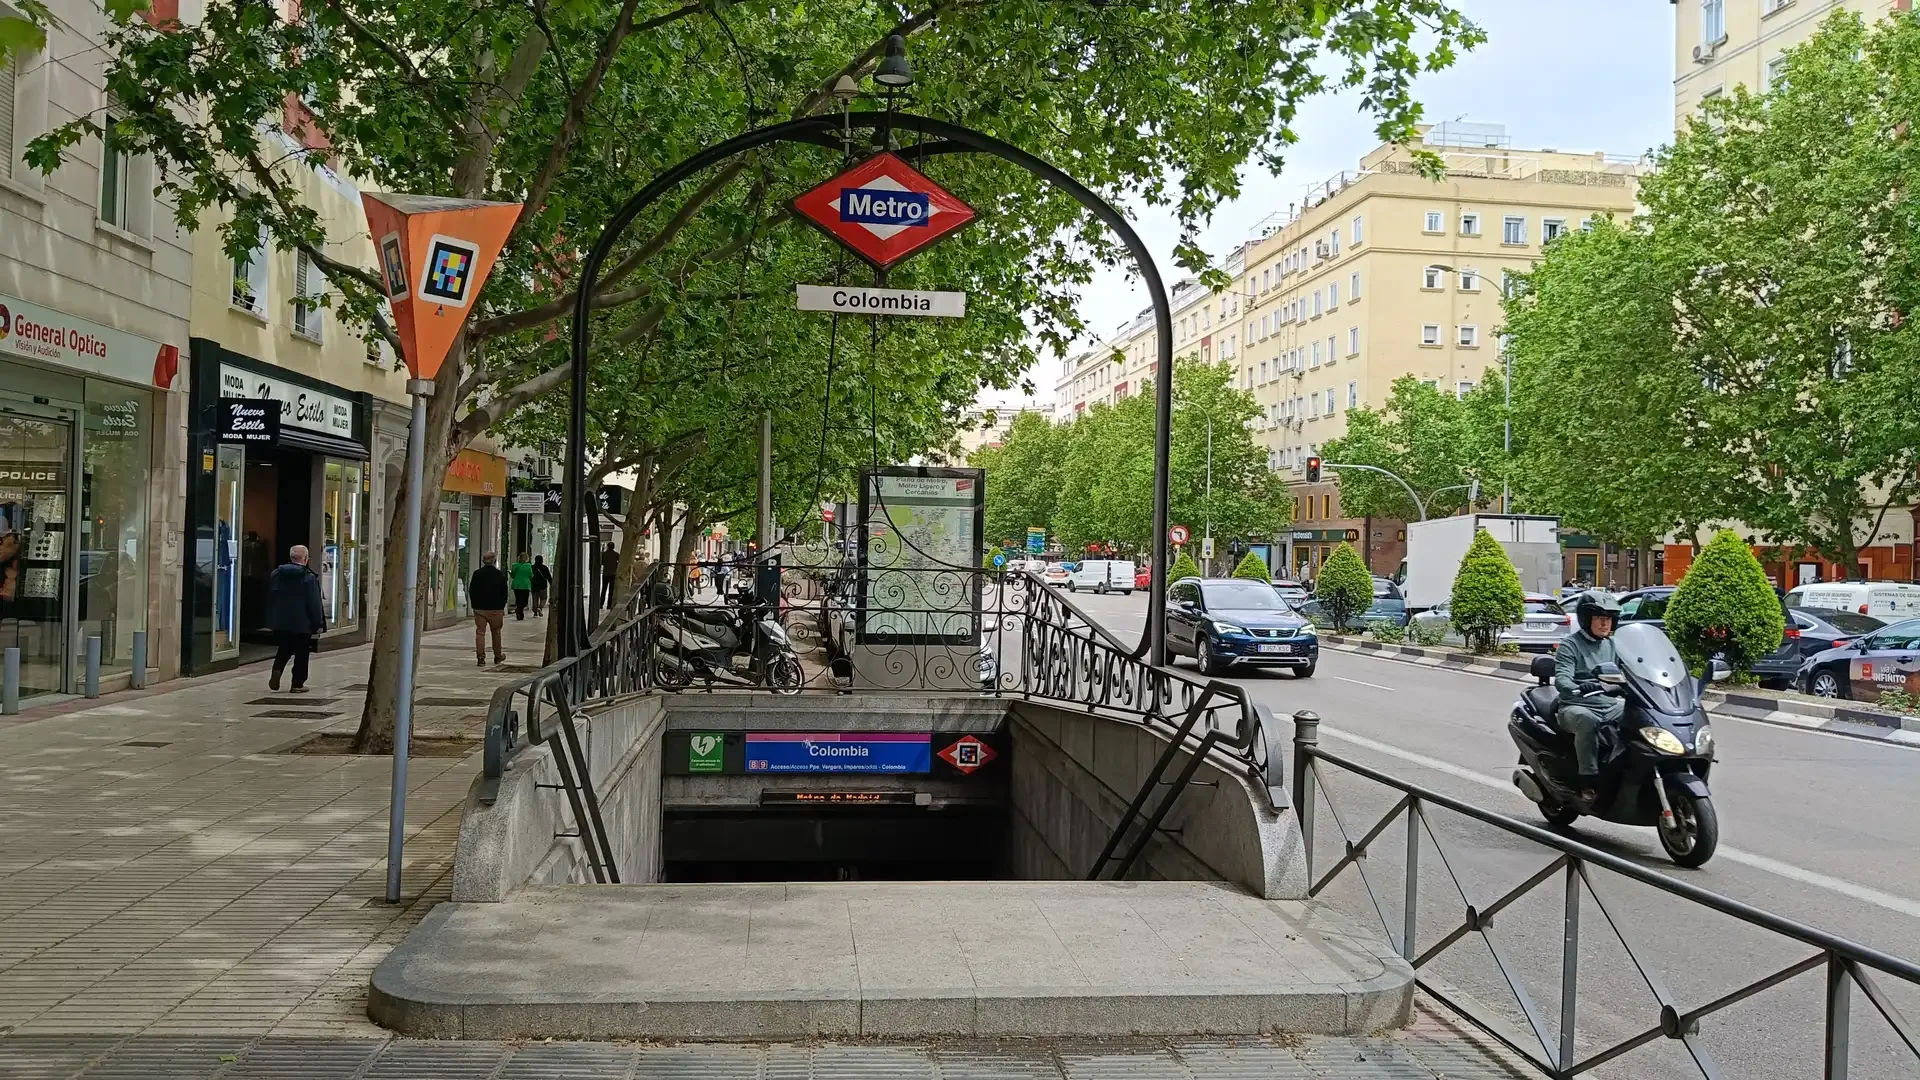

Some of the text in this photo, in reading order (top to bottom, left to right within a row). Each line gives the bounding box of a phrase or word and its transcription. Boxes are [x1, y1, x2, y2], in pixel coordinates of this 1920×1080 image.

[848, 193, 923, 219] Metro
[832, 291, 931, 310] Colombia
[14, 314, 107, 357] General Optica
[15, 339, 61, 358] Visión y Audición
[224, 373, 244, 390] MODA
[230, 403, 266, 416] Nuevo
[257, 382, 325, 423] Nvo Estilo
[333, 404, 348, 417] MODA
[231, 417, 266, 431] Estilo
[332, 417, 350, 430] MUJER
[0, 471, 57, 480] POLICE
[1873, 672, 1906, 684] INFINITO
[809, 745, 869, 757] Colombia
